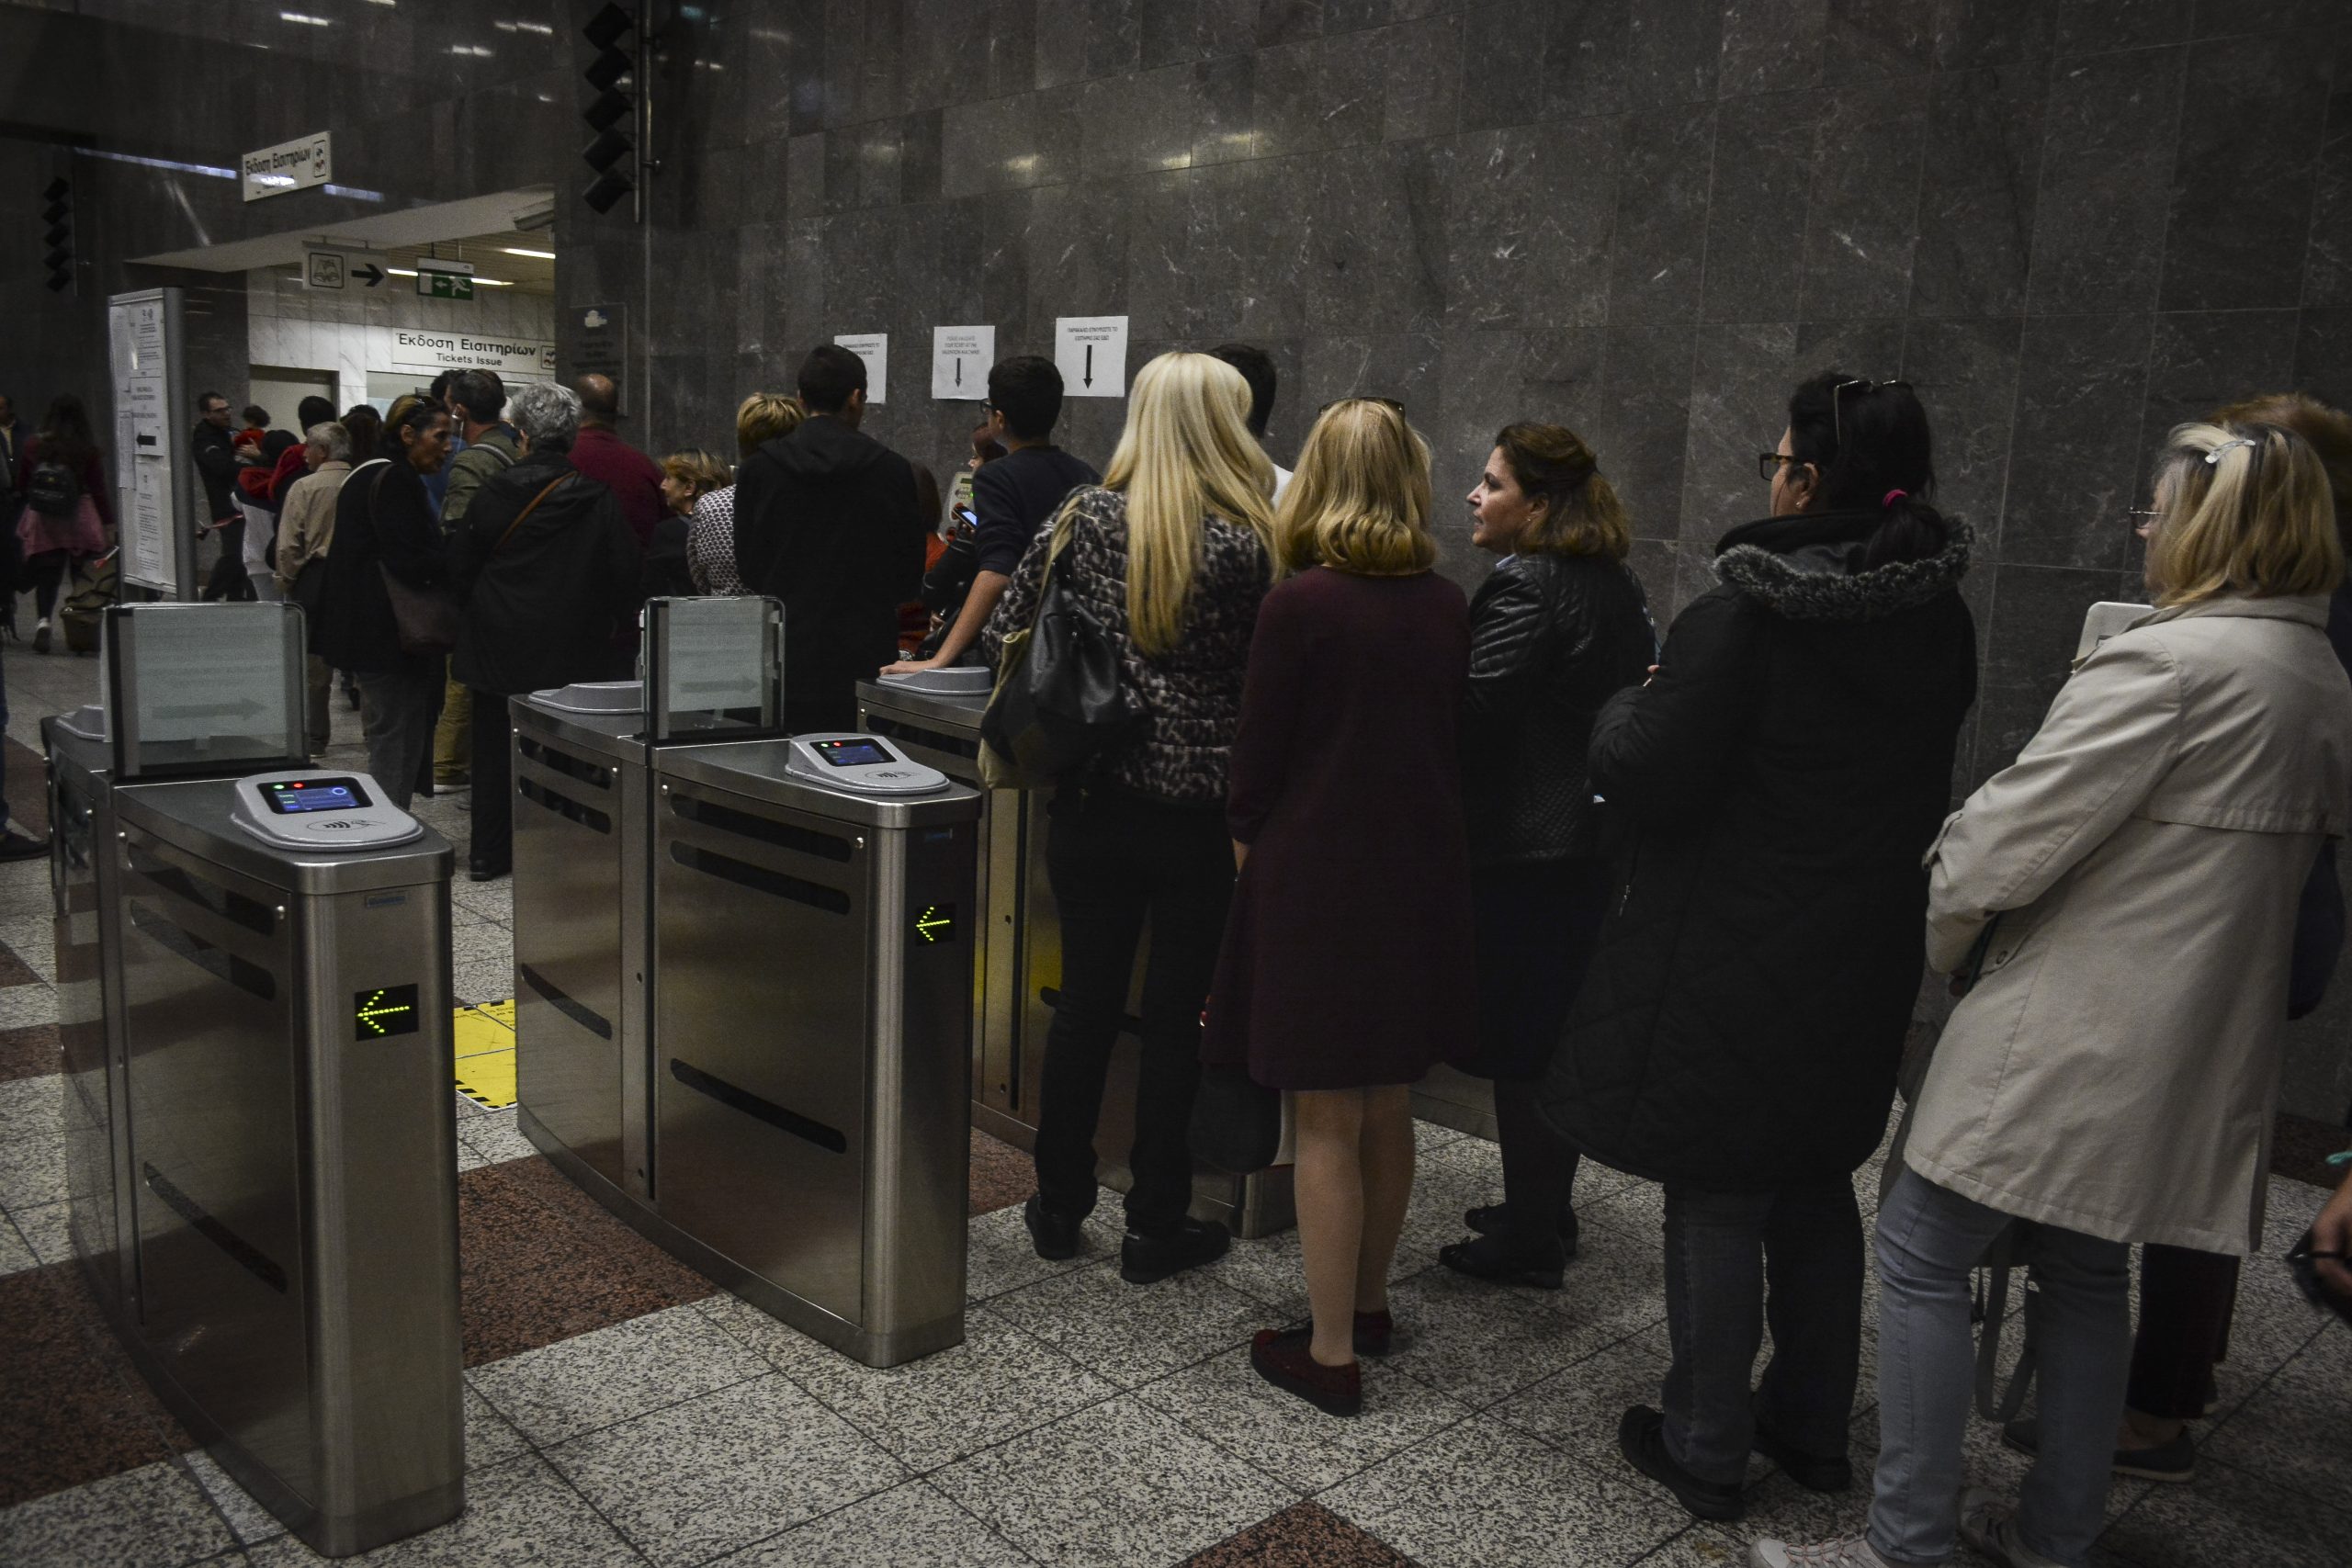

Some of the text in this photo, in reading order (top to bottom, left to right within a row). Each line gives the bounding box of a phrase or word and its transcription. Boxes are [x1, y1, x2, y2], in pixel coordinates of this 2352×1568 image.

[396, 333, 537, 355] Έκδοση Εισιτηρίων
[436, 353, 503, 367] Tickets Issue
